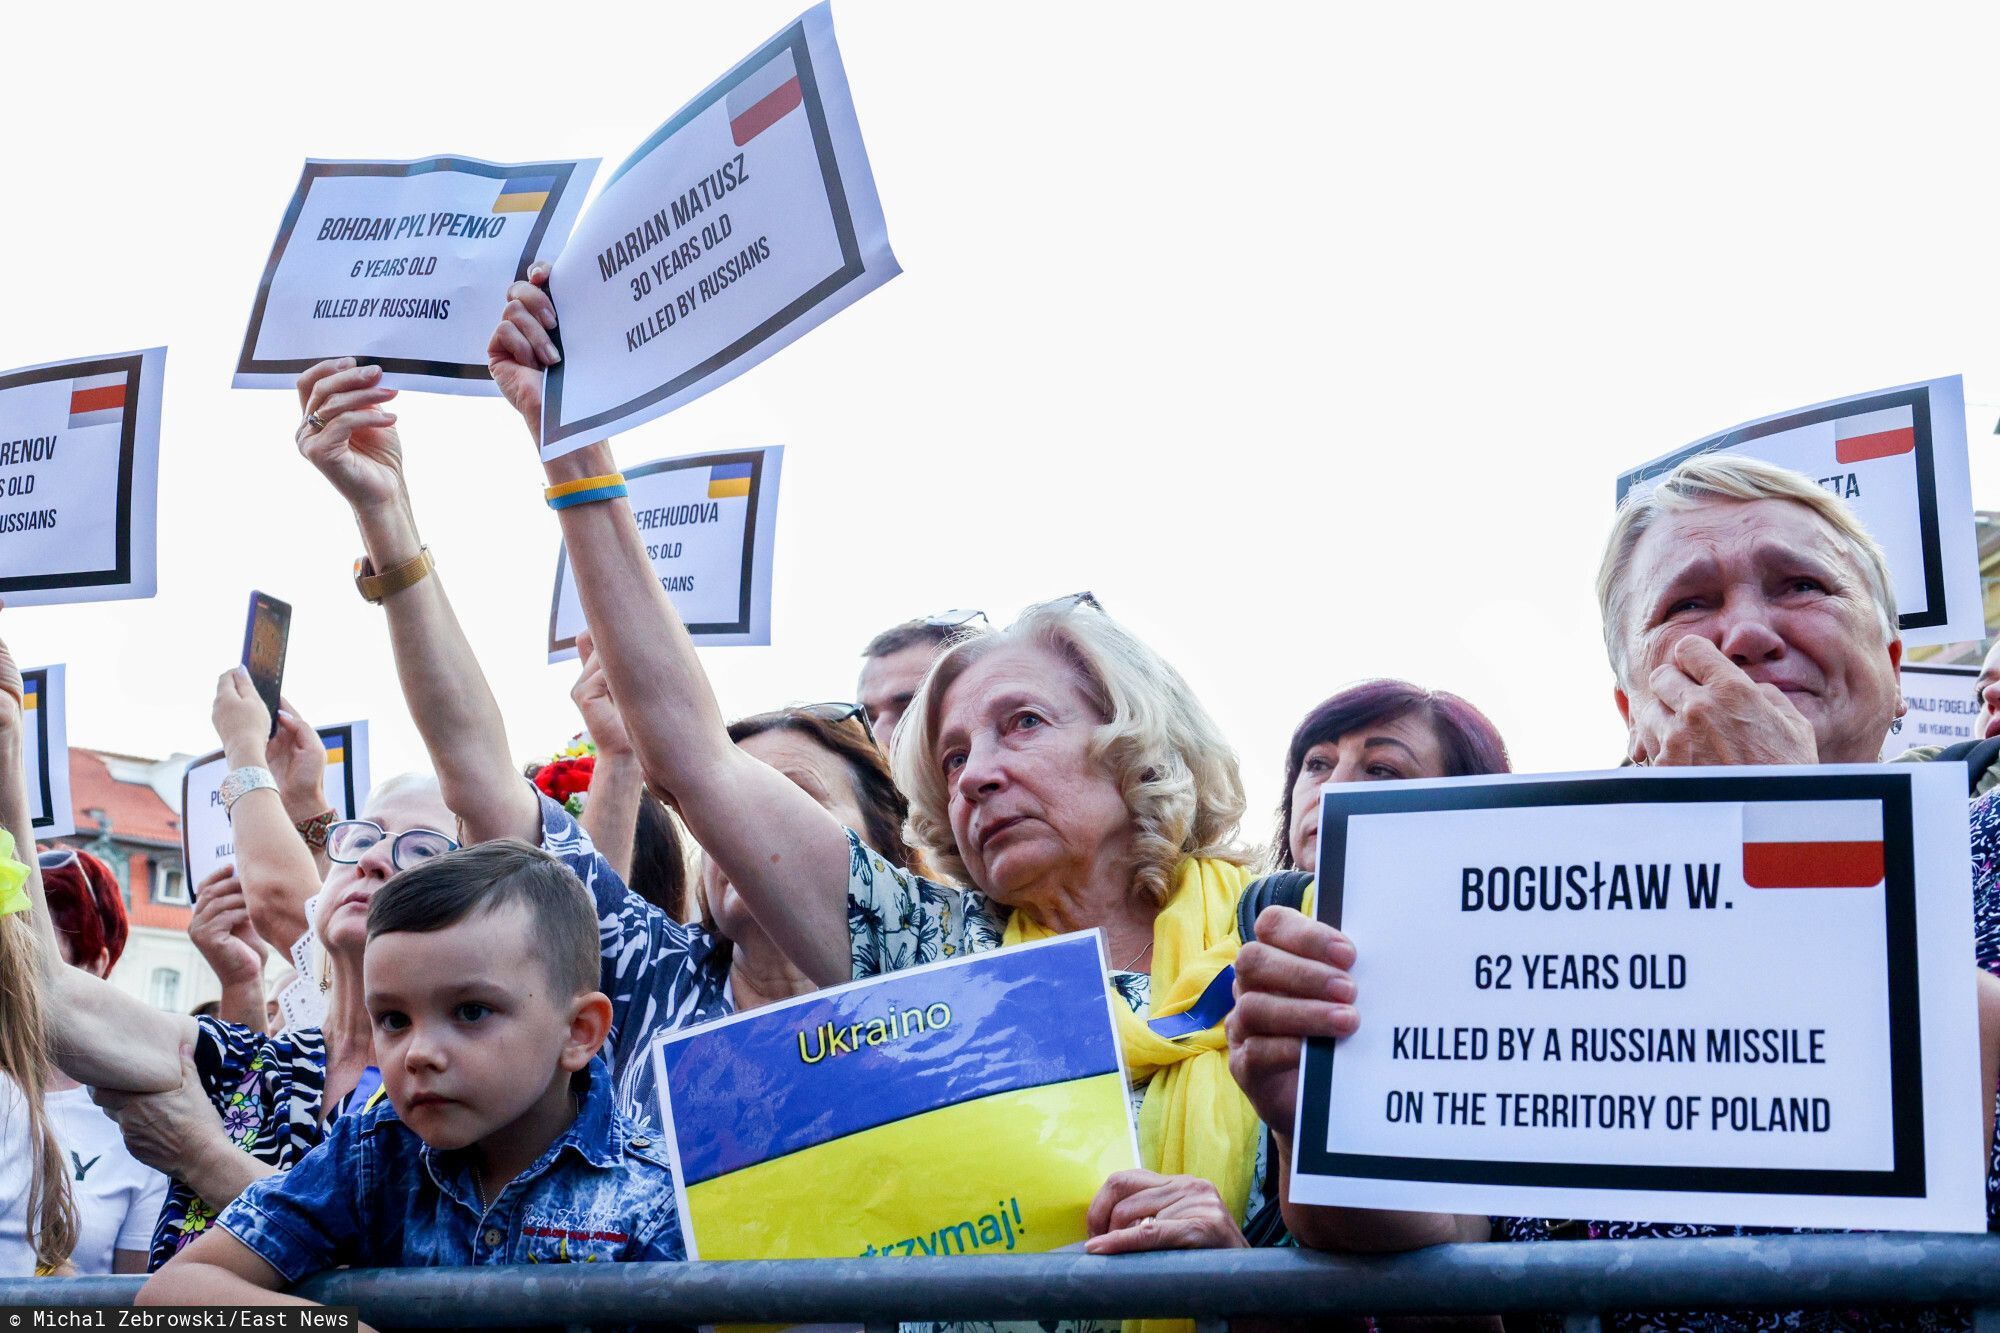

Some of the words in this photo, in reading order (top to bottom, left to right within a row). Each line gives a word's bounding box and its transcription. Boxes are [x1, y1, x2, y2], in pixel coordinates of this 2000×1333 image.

[316, 217, 396, 241] BOHDAN
[394, 212, 507, 240] PYLYPENKO
[597, 209, 671, 283] MARIAN
[670, 152, 750, 230] MATUSZ
[350, 260, 364, 278] 6
[364, 257, 408, 278] YEARS
[408, 256, 438, 276] OLD
[630, 271, 652, 302] 30
[651, 235, 701, 286] YEARS
[701, 213, 732, 251] OLD
[313, 298, 358, 319] KILLED
[358, 298, 380, 318] BY
[379, 298, 451, 320] RUSSIANS
[625, 302, 677, 353] KILLED
[676, 286, 697, 319] BY
[698, 235, 771, 303] RUSSIANS
[8, 474, 35, 497] OLD
[633, 502, 718, 530] EREHUDOVA
[661, 542, 682, 559] OLD
[658, 575, 695, 592] SIANS
[1930, 723, 1953, 736] YEARS
[1955, 725, 1970, 737] OLD
[1685, 862, 1734, 911] W.
[1474, 953, 1512, 991] 62
[1521, 952, 1620, 990] YEARS
[1629, 953, 1687, 990] OLD
[797, 1002, 952, 1065] Ukraino
[1392, 1026, 1488, 1061] KILLED
[1498, 1027, 1536, 1061] BY
[1542, 1027, 1562, 1062] A
[1570, 1028, 1697, 1063] RUSSIAN
[1706, 1028, 1827, 1064] MISSILE
[1386, 1090, 1429, 1124] ON
[1433, 1091, 1487, 1126] THE
[1495, 1092, 1656, 1130] TERRITORY
[1665, 1095, 1702, 1131] OF
[1711, 1096, 1831, 1133] POLAND
